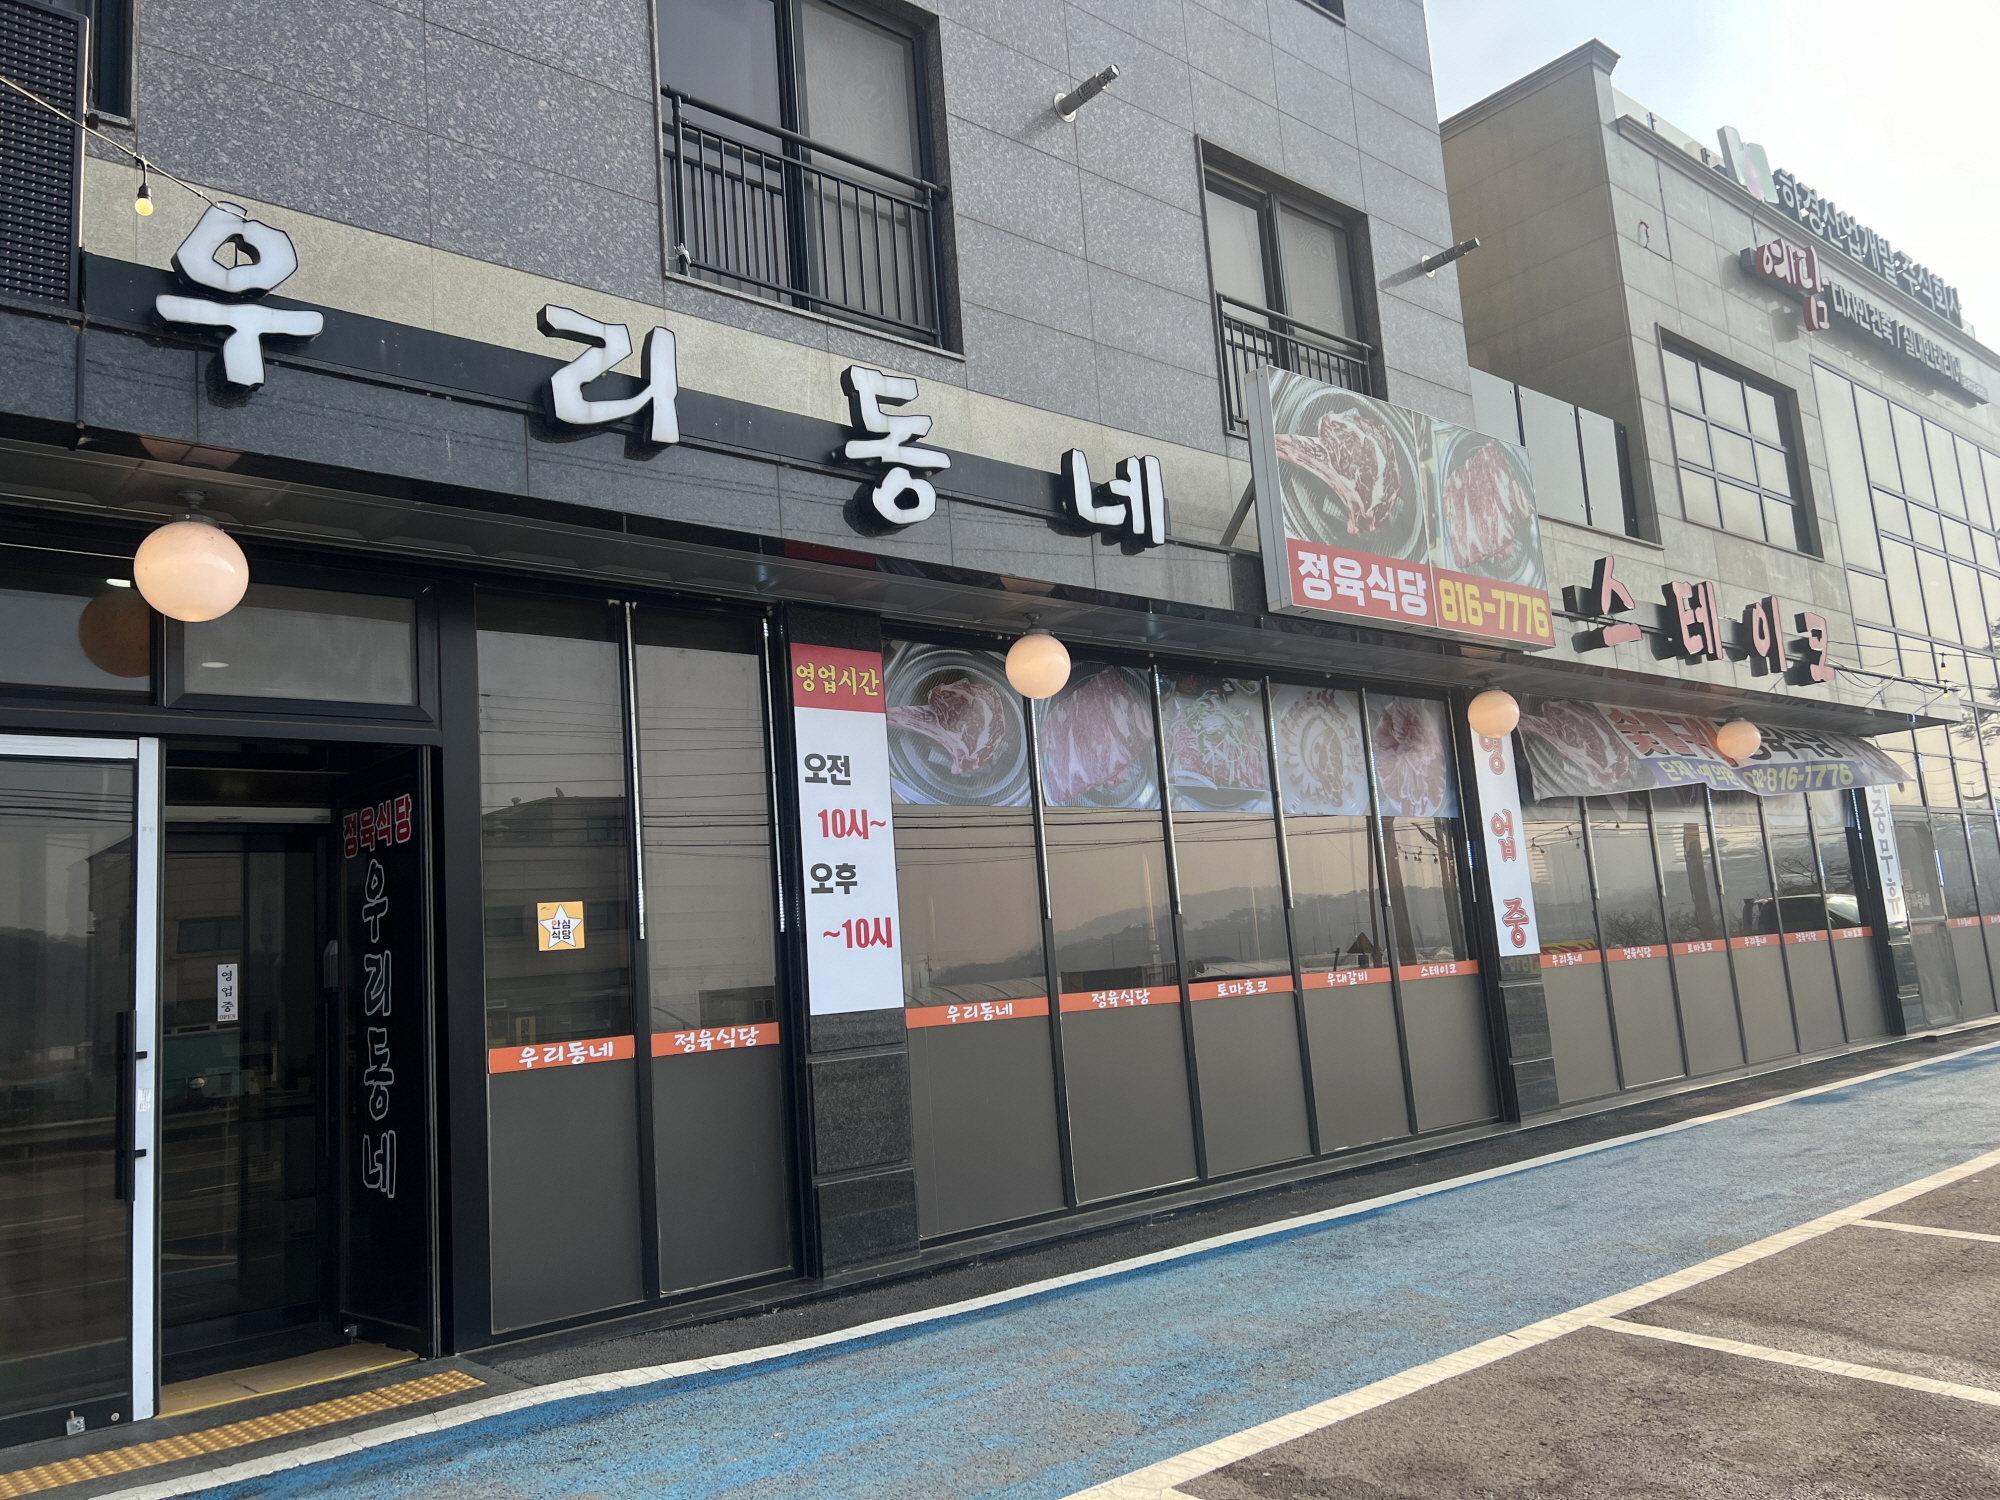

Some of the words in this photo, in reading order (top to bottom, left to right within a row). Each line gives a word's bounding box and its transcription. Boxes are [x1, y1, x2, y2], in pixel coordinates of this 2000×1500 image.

[155, 203, 1168, 547] 우리동네
[1297, 551, 1428, 617] 정육식당
[1438, 578, 1550, 637] 816-7776
[1600, 555, 1836, 683] 스테이크
[796, 662, 880, 697] 영업시간
[1607, 707, 1739, 768] 숯불구이
[803, 753, 852, 786] 오전
[343, 794, 412, 858] 정육식당
[818, 808, 887, 840] 10시~
[810, 862, 858, 894] 오후
[551, 919, 571, 930] 안심
[551, 930, 572, 940] 식당
[823, 917, 893, 949] ~10시
[1622, 947, 1652, 960] 정육식당
[1686, 942, 1713, 954] 토마호크
[1744, 935, 1767, 947] 우리동네
[1420, 963, 1458, 977] 스테이크
[1551, 953, 1583, 966] 우리동네
[221, 970, 234, 1012] 영업중
[1216, 979, 1269, 998] 토마호크
[1326, 970, 1368, 986] 우대갈비
[1090, 988, 1151, 1008] 정육식당
[946, 1002, 1014, 1024] 우리동네
[362, 858, 397, 1198] 우리동네
[674, 1026, 760, 1053] 정육식당
[518, 1041, 614, 1068] 우리동네
